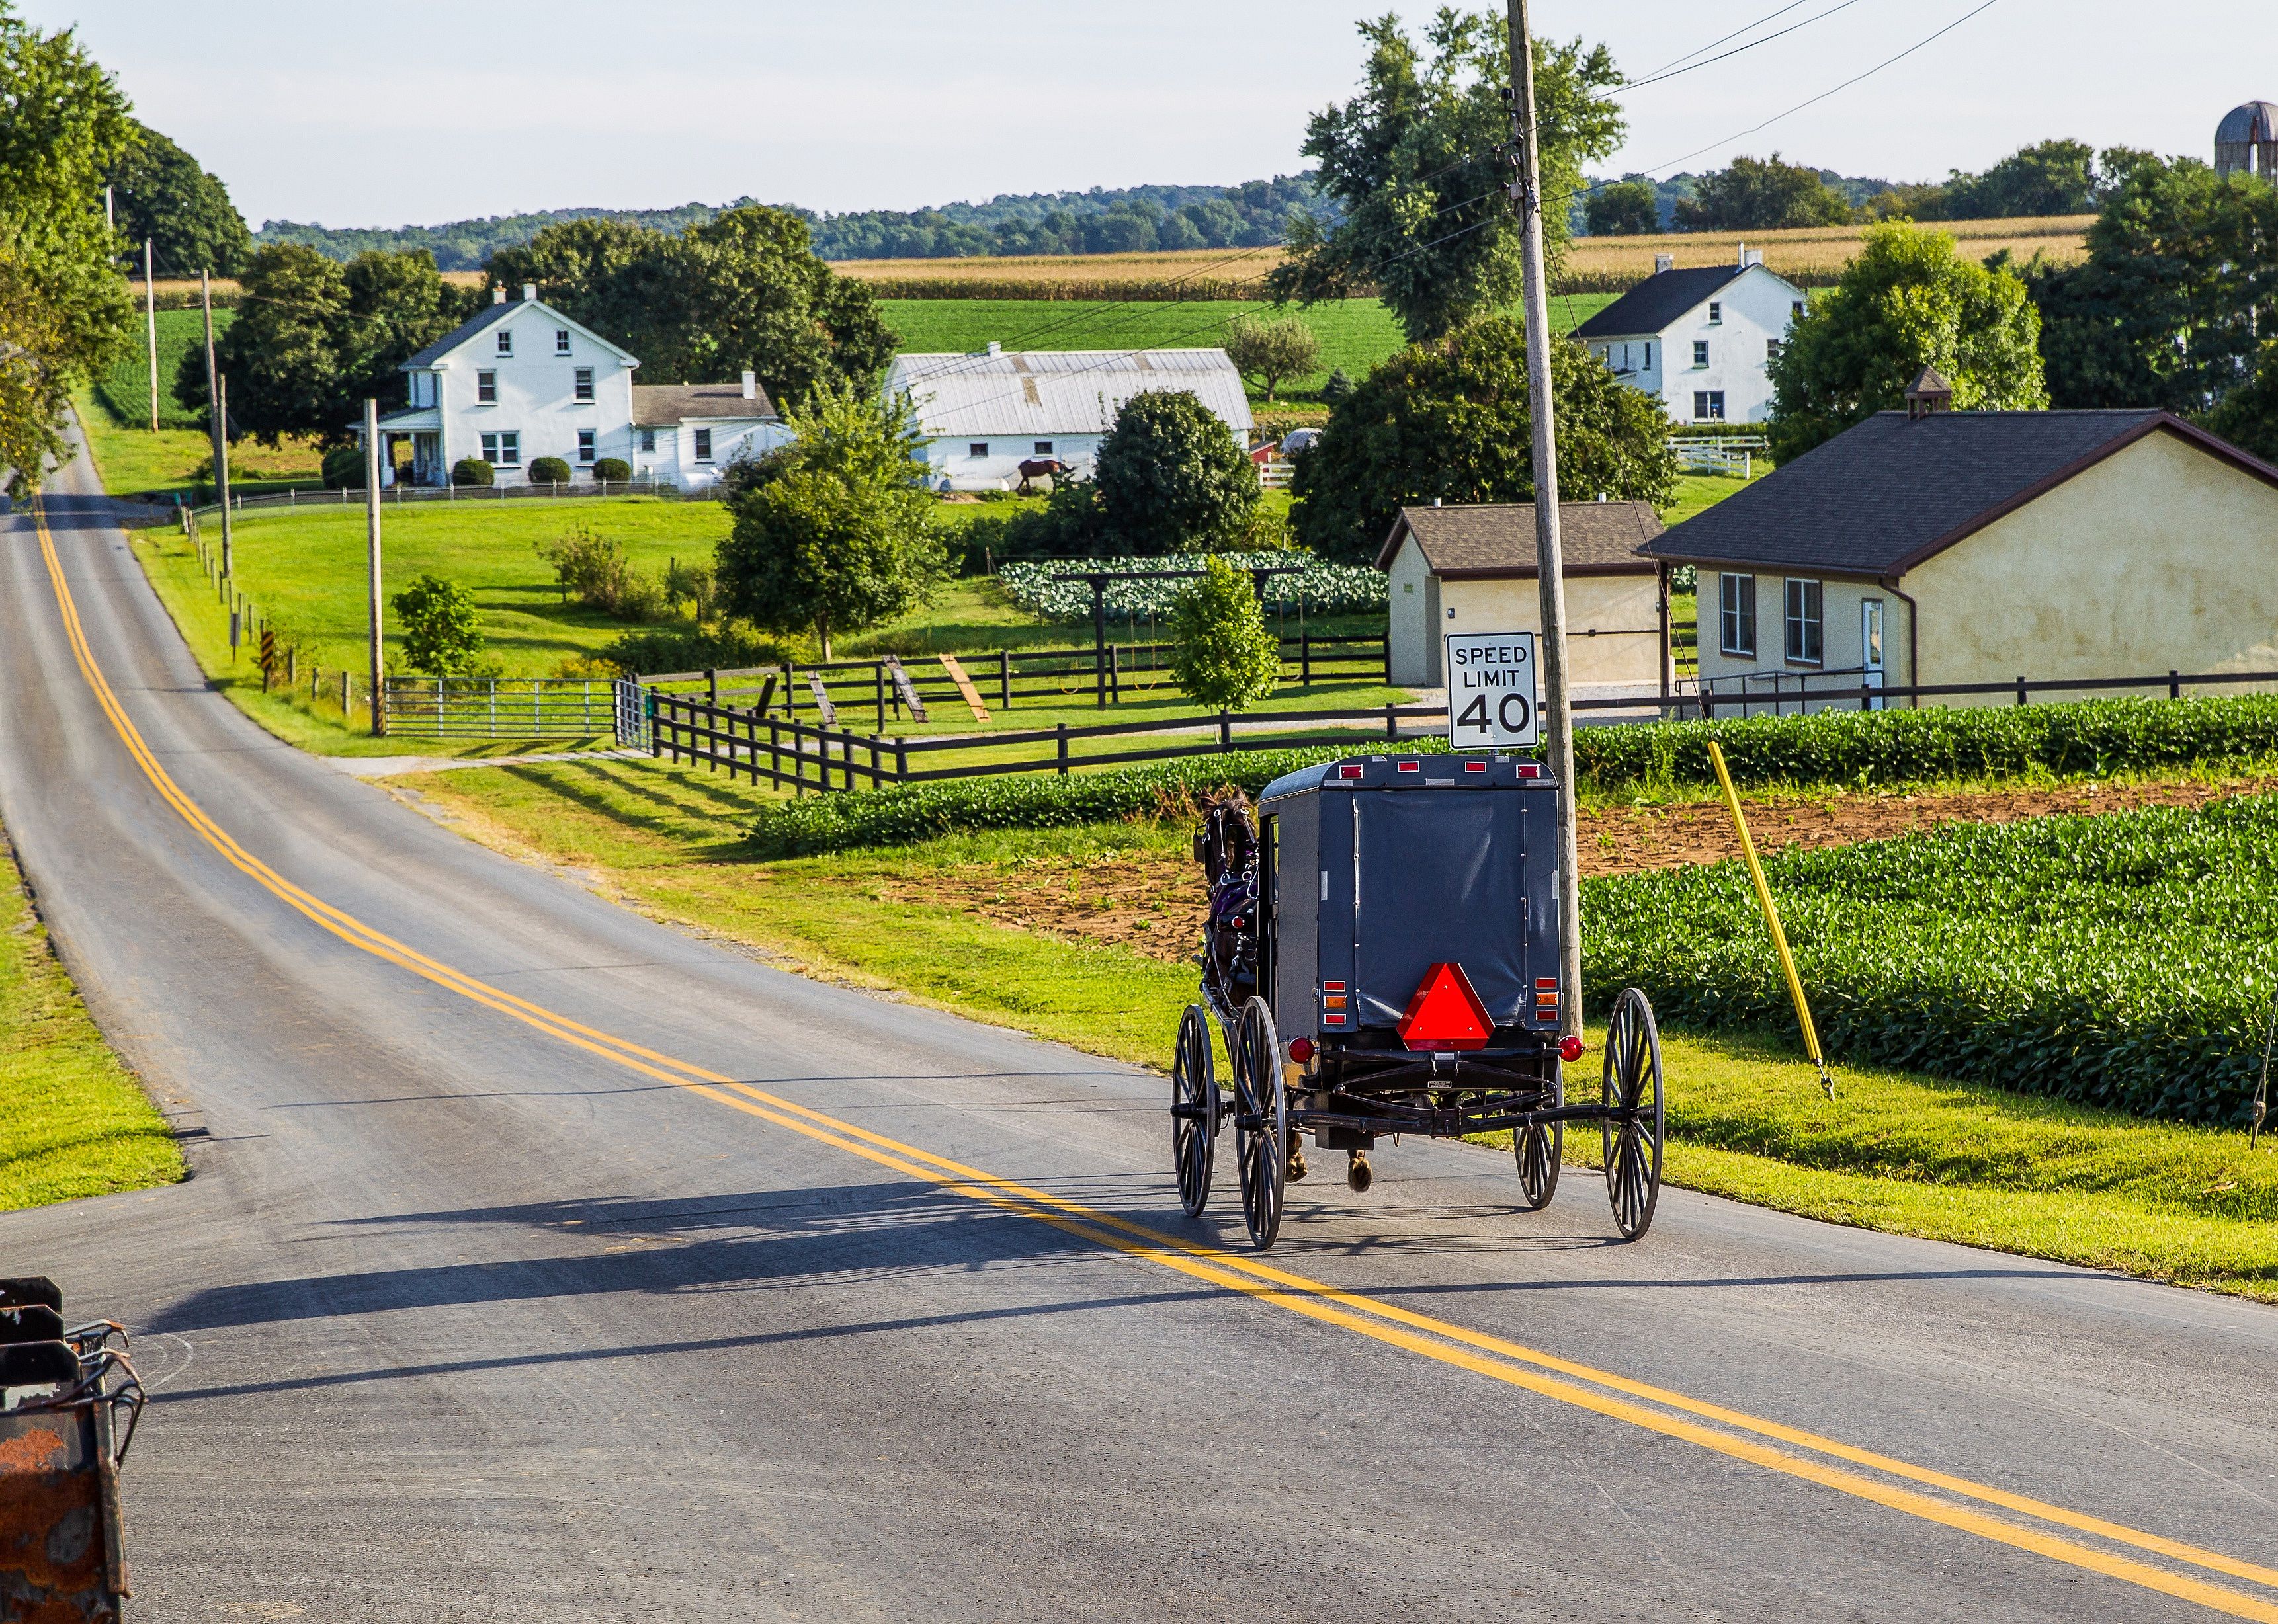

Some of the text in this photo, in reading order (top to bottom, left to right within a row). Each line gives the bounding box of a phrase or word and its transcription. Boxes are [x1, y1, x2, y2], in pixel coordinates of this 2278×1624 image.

[1455, 646, 1527, 665] SPEED
[1464, 669, 1519, 688] LIMIT
[1456, 692, 1530, 734] 40
